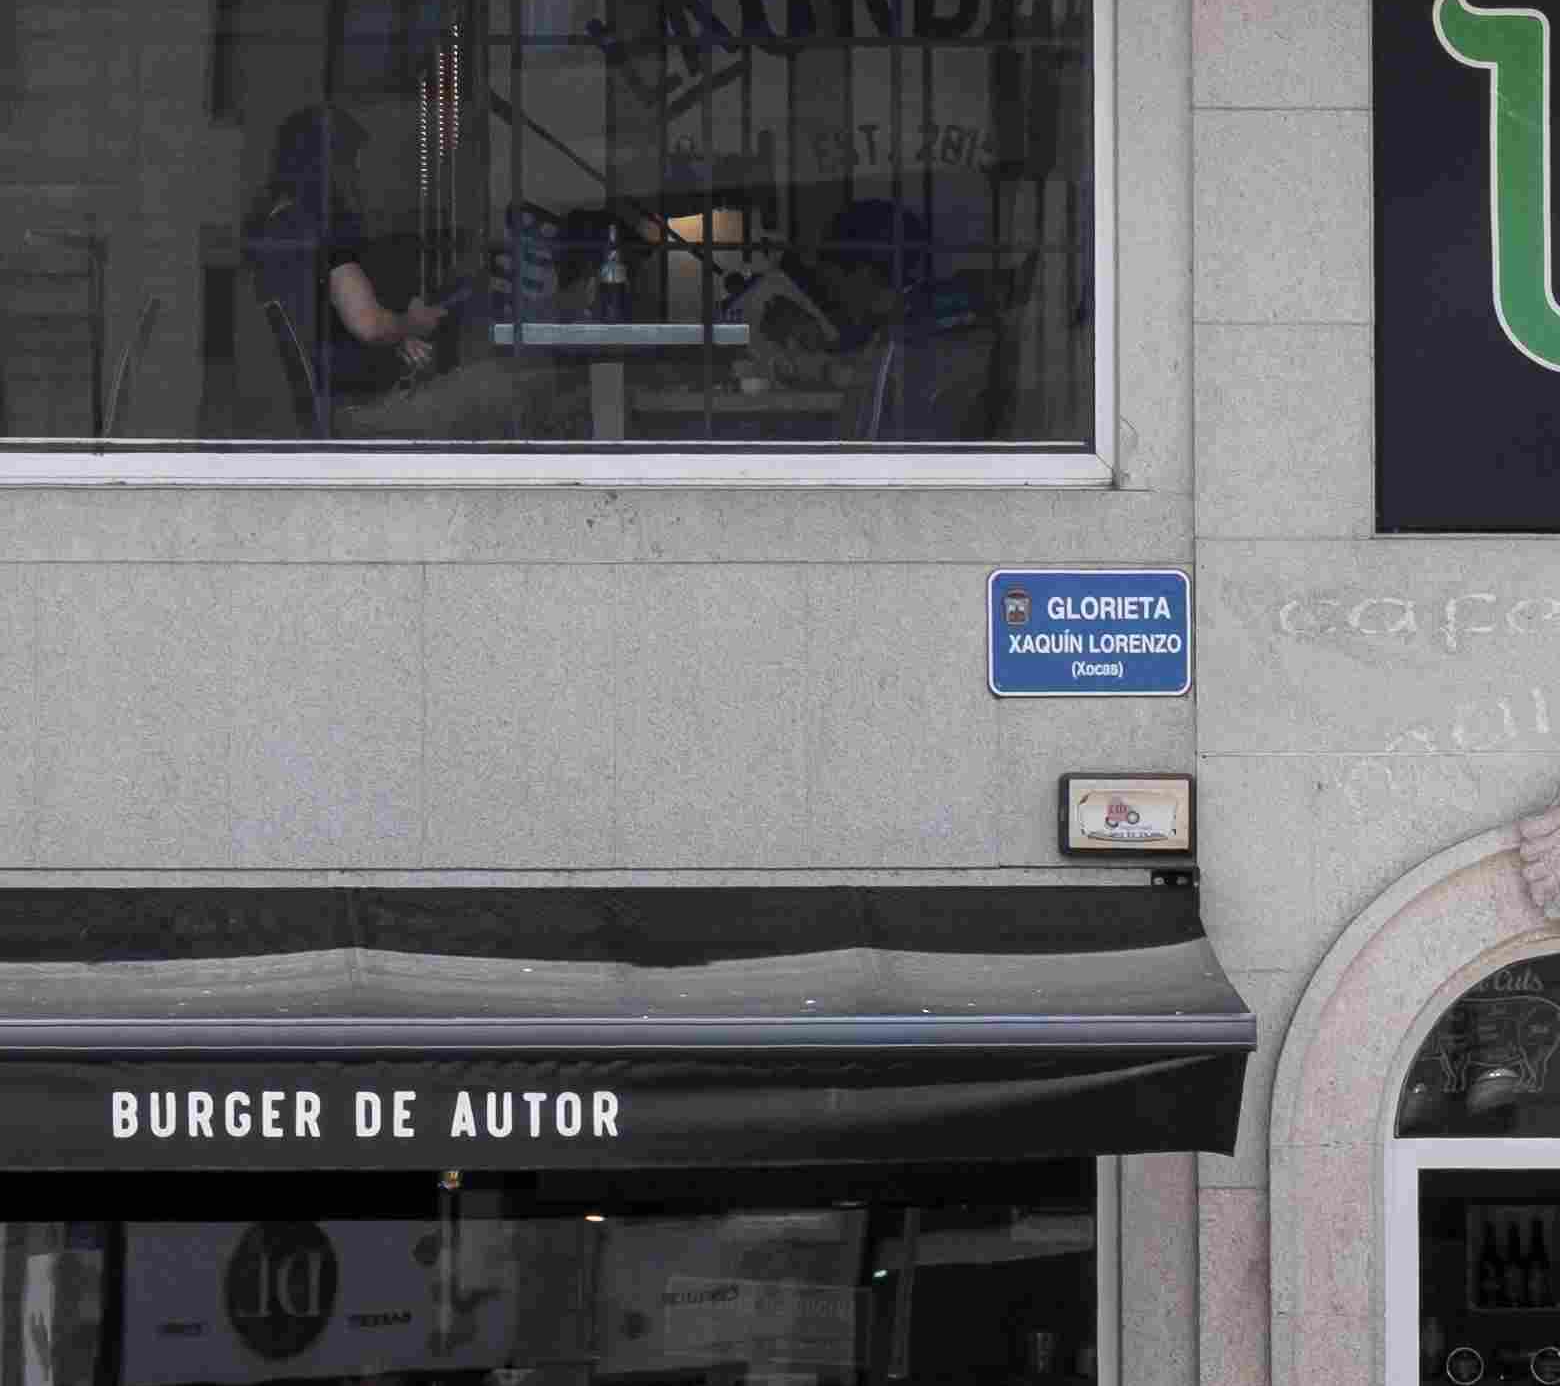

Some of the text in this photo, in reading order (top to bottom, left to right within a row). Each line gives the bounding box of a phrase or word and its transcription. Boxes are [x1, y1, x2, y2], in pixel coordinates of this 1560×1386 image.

[1047, 596, 1171, 620] GLORIETA
[1009, 629, 1182, 654] XAQUÍN LORENZO
[1071, 661, 1124, 678] (Xocas)
[111, 1089, 620, 1139] BURGER DE AUTOR
